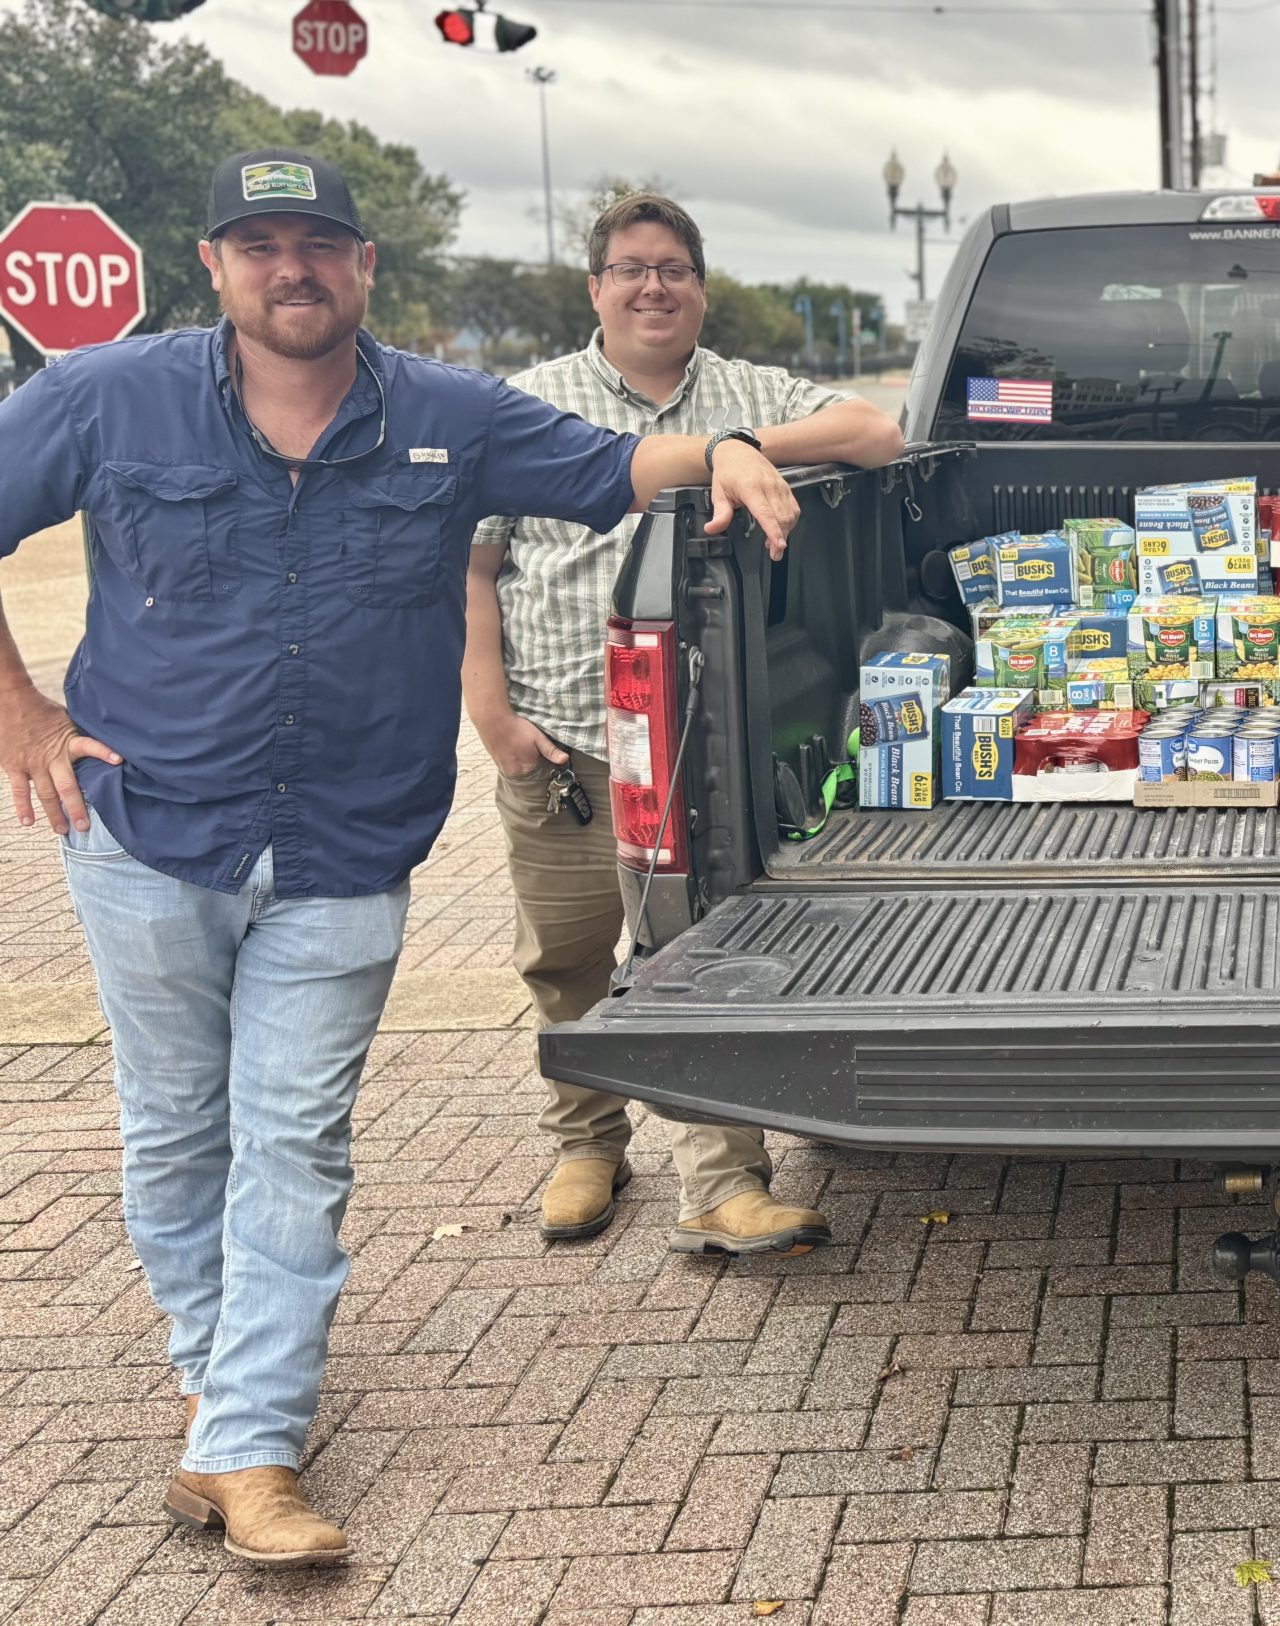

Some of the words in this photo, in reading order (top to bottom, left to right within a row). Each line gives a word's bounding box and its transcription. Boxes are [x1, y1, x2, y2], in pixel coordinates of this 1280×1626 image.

[296, 21, 366, 53] STOP
[5, 250, 130, 308] STOP
[984, 405, 1004, 414] God
[1006, 406, 1021, 415] We
[1024, 407, 1049, 416] Trust
[1166, 522, 1189, 530] Black
[1143, 540, 1160, 548] CANS
[1201, 531, 1229, 546] BUSH'S
[1160, 540, 1167, 552] 6
[1002, 552, 1006, 560] 6
[972, 560, 990, 574] BUS
[1017, 563, 1054, 578] BUSH'S
[1227, 558, 1234, 570] 6
[1165, 566, 1192, 580] BUSH'S
[1204, 580, 1228, 589] Black
[1230, 581, 1255, 590] Beans
[1018, 588, 1044, 598] Beautiful
[1122, 594, 1132, 602] 8
[1199, 620, 1208, 632] 8
[1081, 634, 1110, 645] USH'S
[1050, 646, 1058, 656] 8
[1072, 690, 1082, 700] 8
[881, 702, 892, 720] Black
[903, 700, 920, 734] BUSH'S
[954, 714, 962, 730] That
[954, 732, 962, 762] Beautiful
[891, 747, 900, 775] Black
[978, 736, 994, 778] BUSH'S
[954, 763, 962, 780] Bean
[891, 776, 899, 805] Beans
[914, 782, 922, 802] CANS
